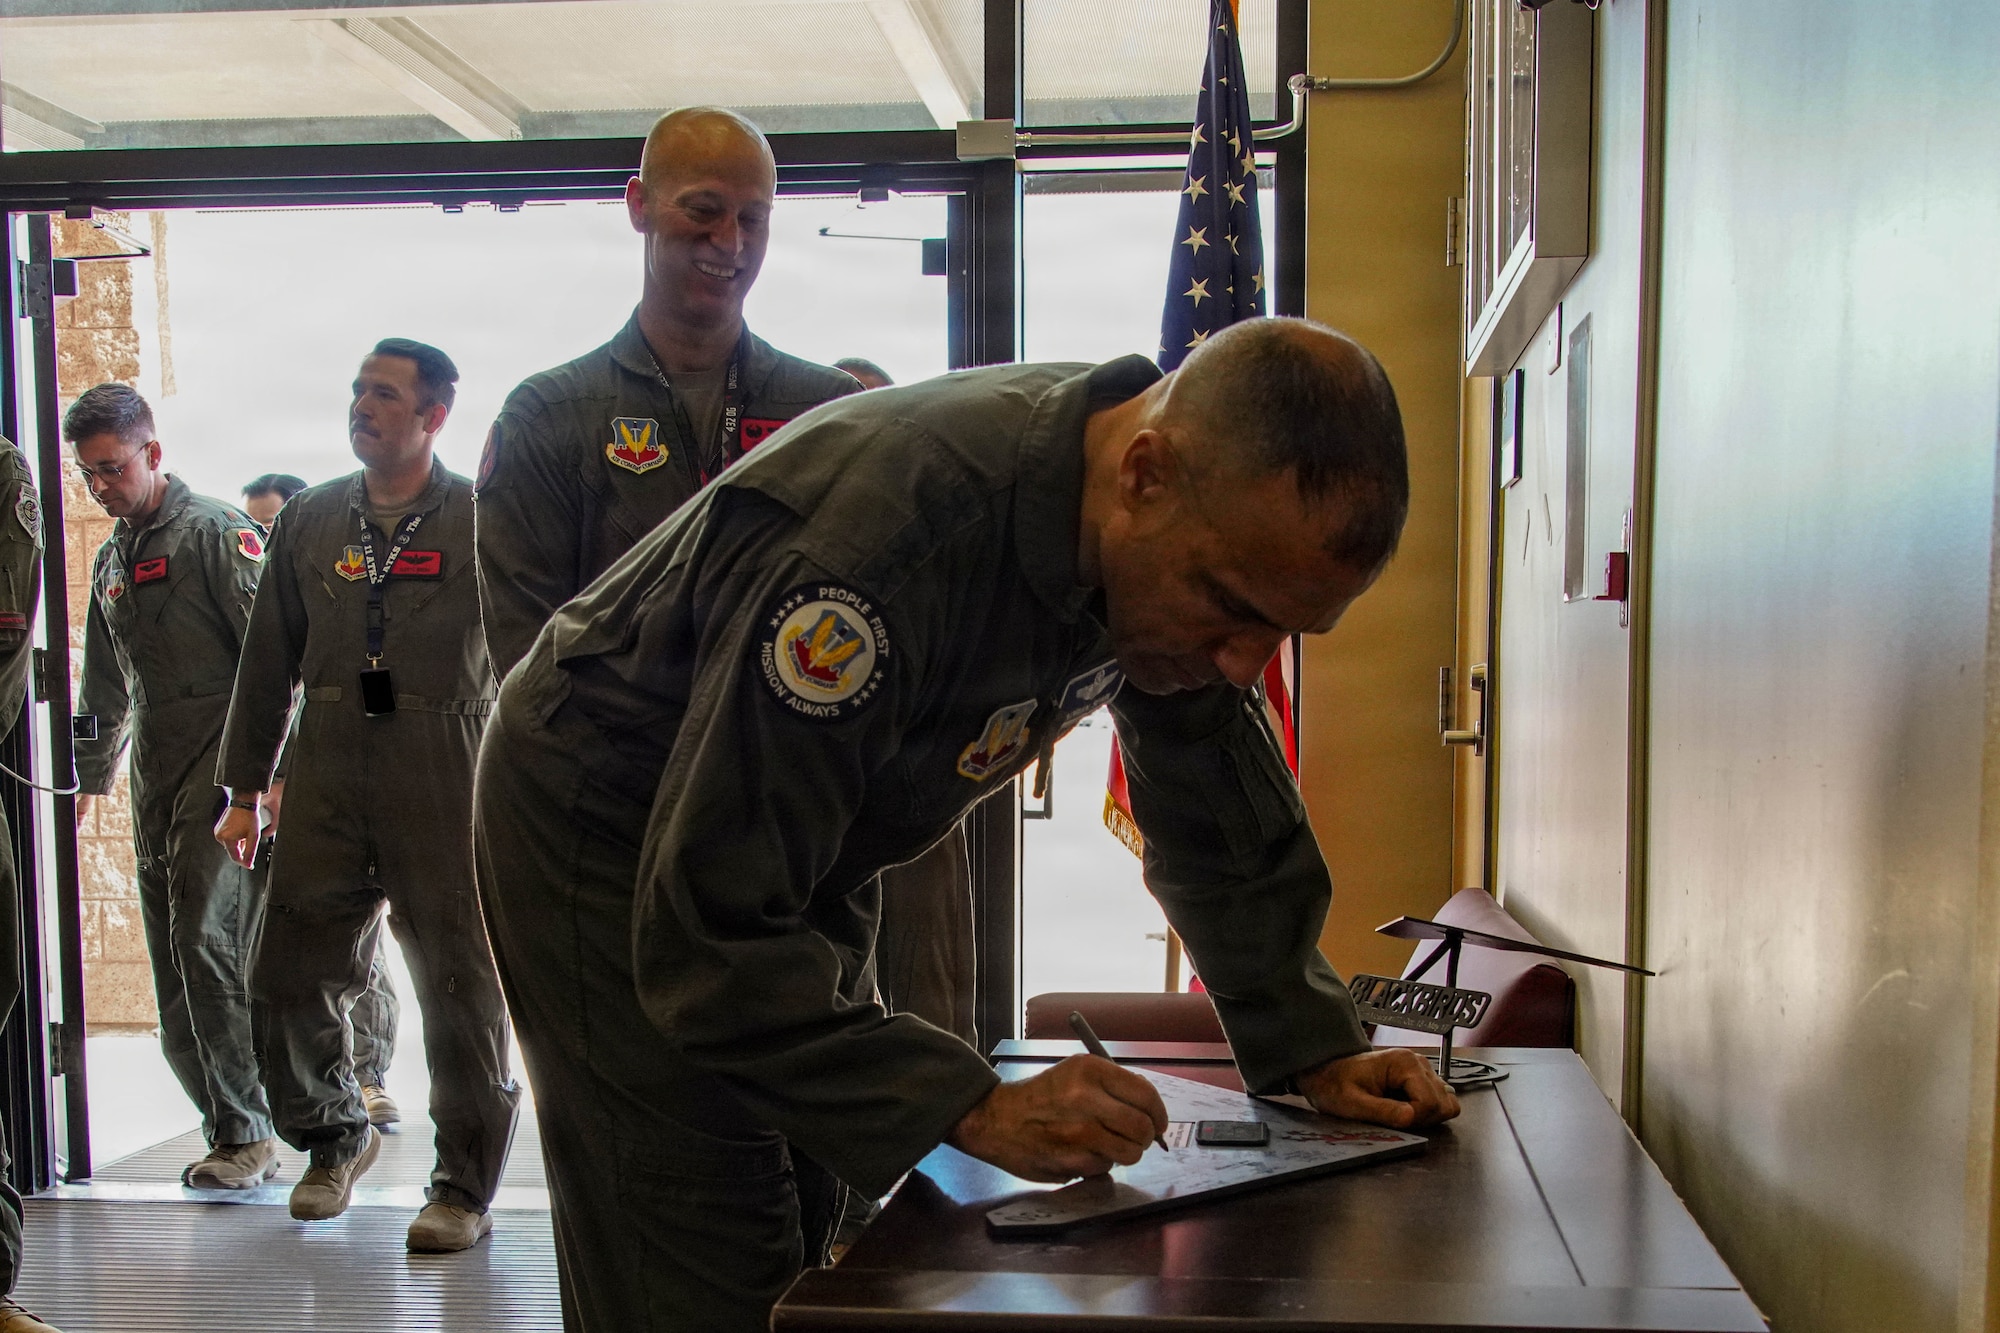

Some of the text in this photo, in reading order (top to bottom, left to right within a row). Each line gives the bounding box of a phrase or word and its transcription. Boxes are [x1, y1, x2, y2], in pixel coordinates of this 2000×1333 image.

[725, 417, 737, 433] 432
[405, 516, 422, 533] The
[364, 544, 378, 584] 11 ATKS
[382, 545, 401, 573] ATKS
[819, 587, 889, 658] PEOPLE FIRST
[762, 641, 840, 717] MISSION ALWAYS
[1351, 976, 1486, 1025] BLACKBIRDS
